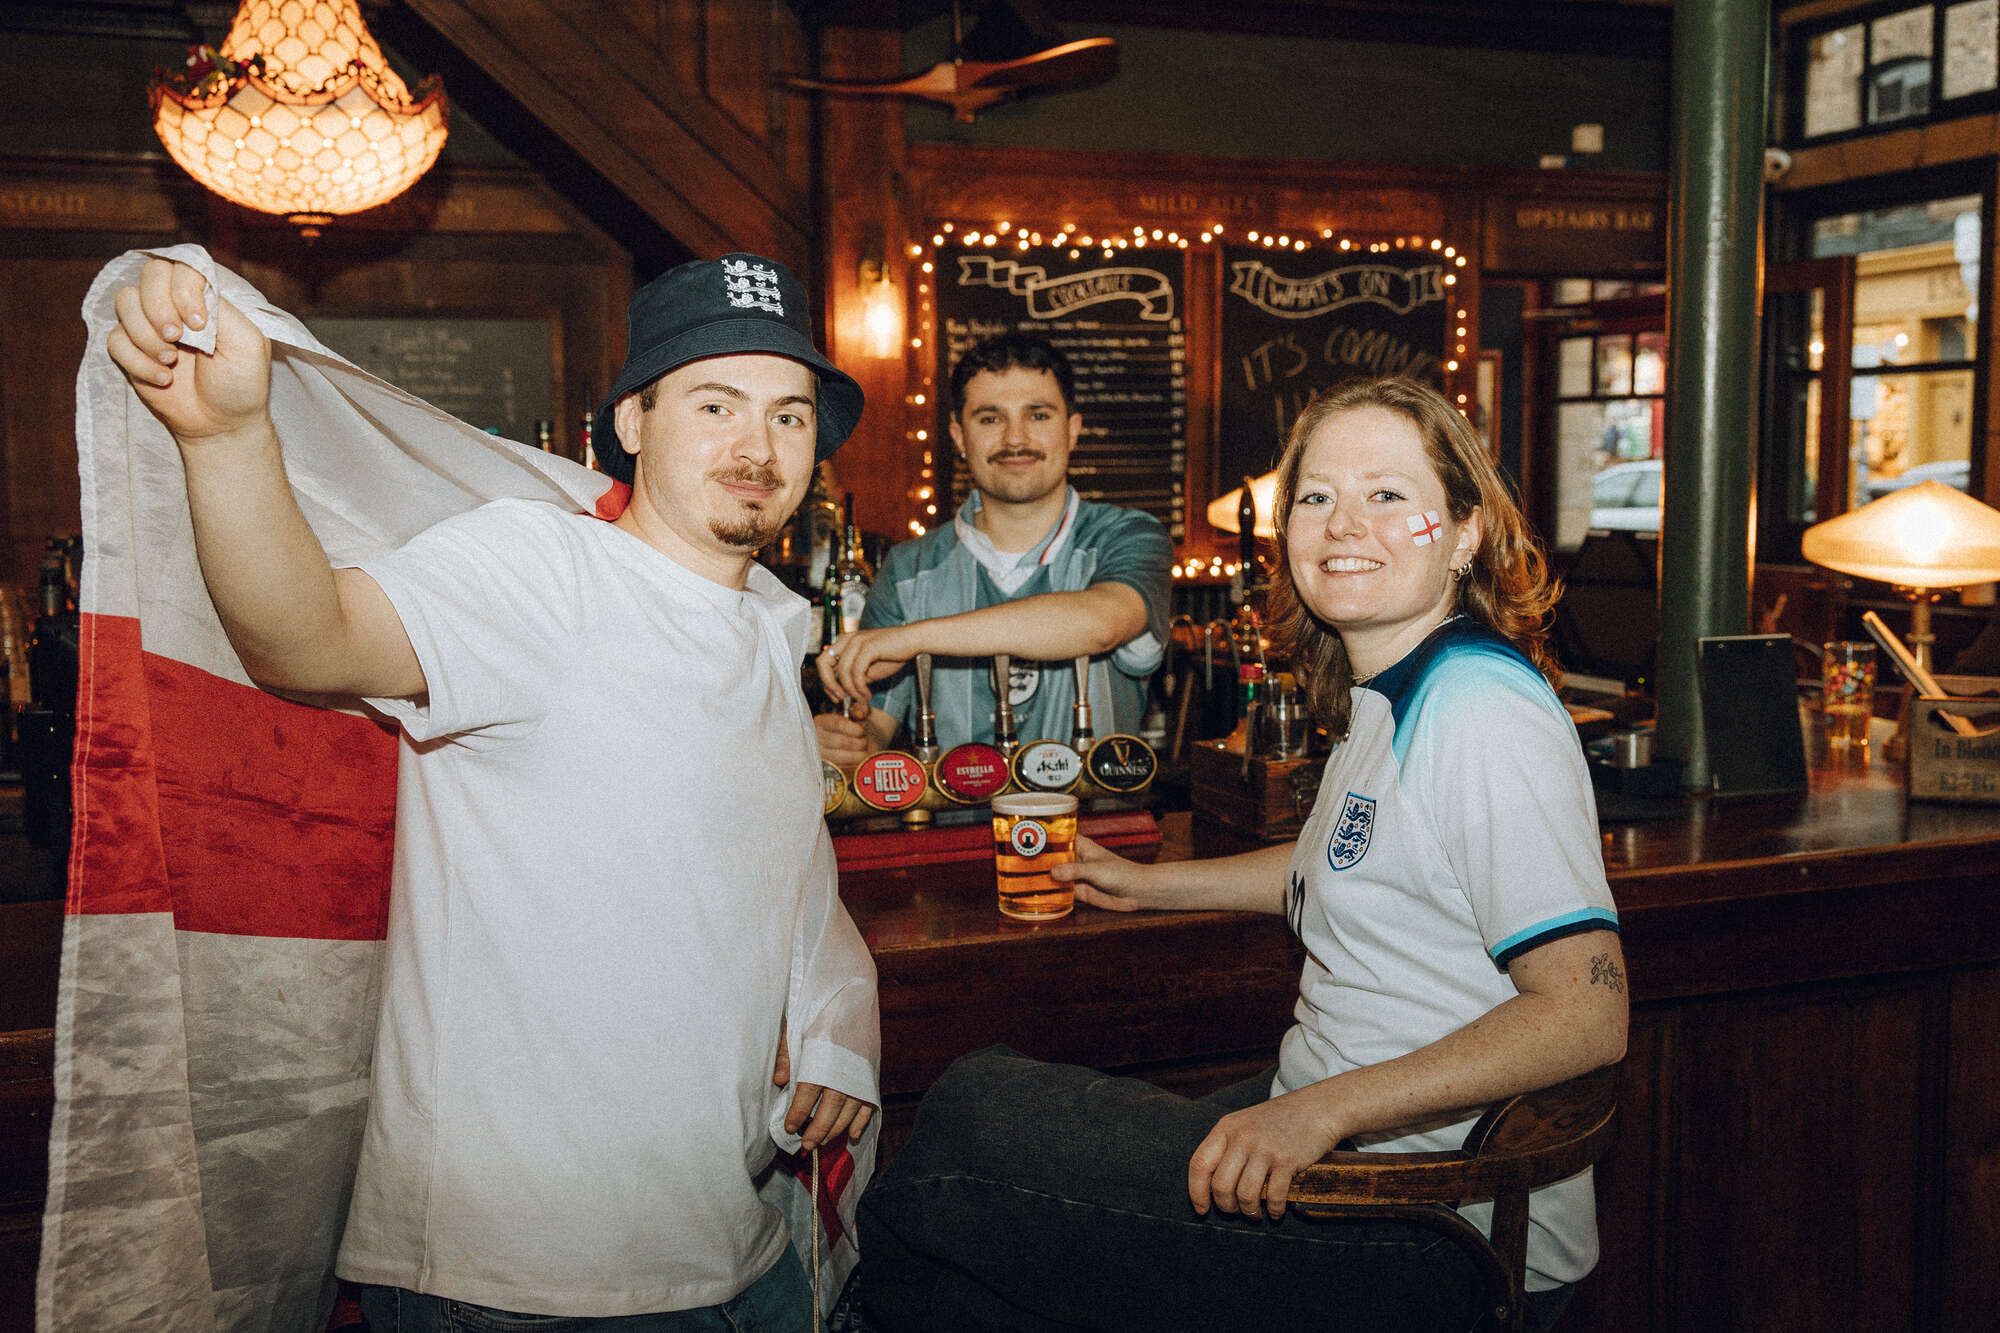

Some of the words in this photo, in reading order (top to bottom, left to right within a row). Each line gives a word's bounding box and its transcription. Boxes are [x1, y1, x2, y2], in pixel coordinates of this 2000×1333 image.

[1139, 194, 1198, 212] MILD
[1517, 208, 1609, 229] UPSTAIRS
[1359, 269, 1392, 297] ON
[1241, 332, 1309, 391] IT'S
[956, 765, 995, 776] ESTRELLA
[1036, 758, 1069, 773] Asahi
[1100, 765, 1148, 776] GUINNESS
[874, 769, 909, 792] HELLS
